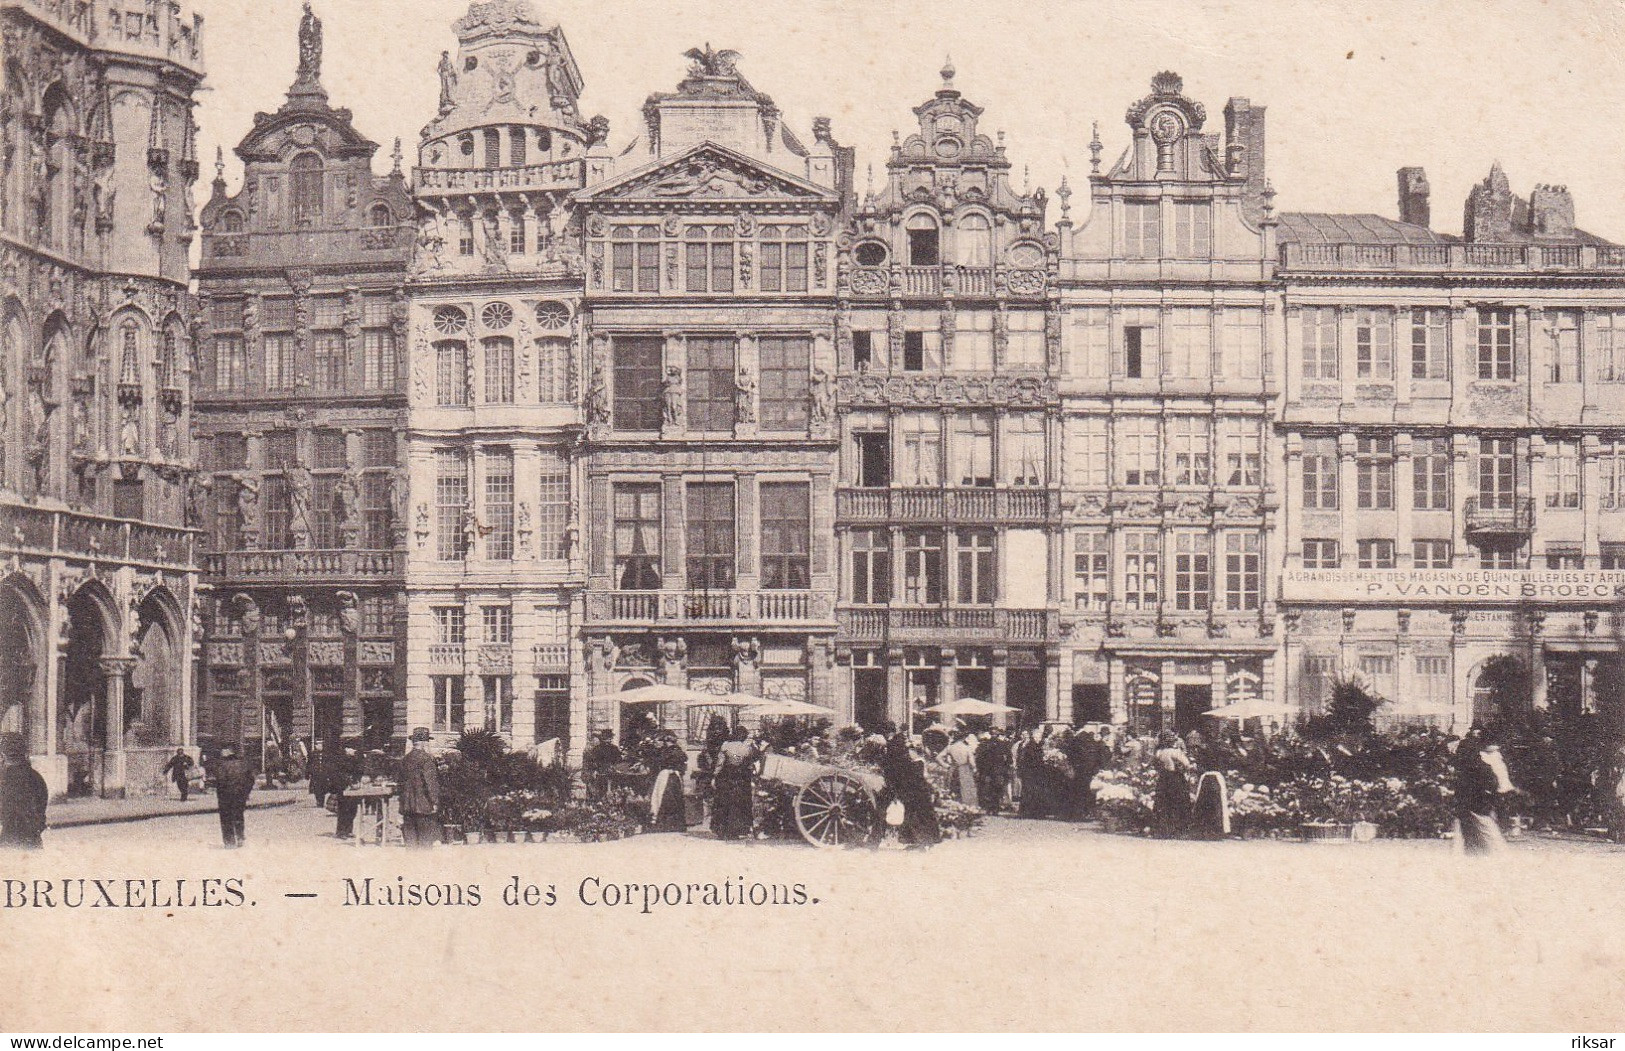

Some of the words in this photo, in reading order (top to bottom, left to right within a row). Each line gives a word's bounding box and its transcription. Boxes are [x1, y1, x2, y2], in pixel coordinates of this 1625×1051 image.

[1288, 571, 1384, 582] AGRANDISSEMENT
[1387, 572, 1406, 582] DES
[1410, 571, 1463, 582] MAGASINS
[1466, 572, 1479, 582] DE
[1483, 571, 1580, 583] QUINCAILLERIES
[1584, 572, 1596, 582] ET
[1367, 582, 1390, 596] P.
[1395, 582, 1510, 597] VANDEN
[1520, 582, 1625, 597] BROECK
